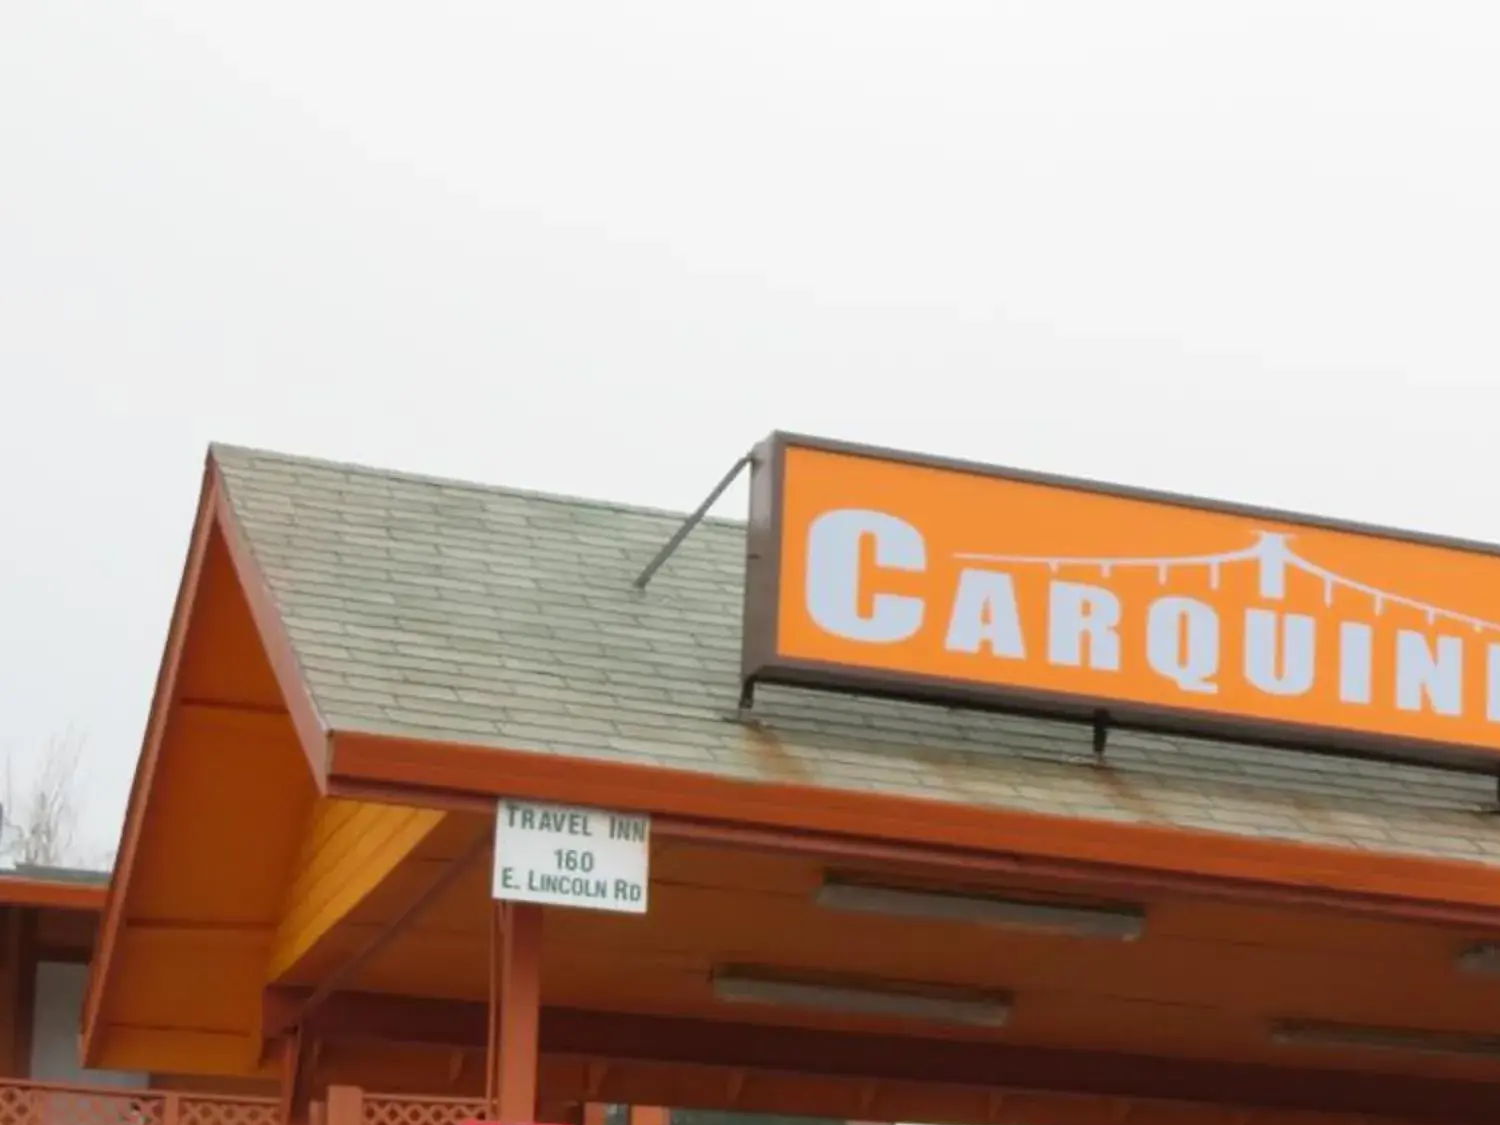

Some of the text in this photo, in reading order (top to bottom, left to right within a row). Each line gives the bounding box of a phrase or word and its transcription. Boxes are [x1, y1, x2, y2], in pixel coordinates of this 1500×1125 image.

[506, 801, 646, 843] TRAVEL INN
[554, 849, 595, 873] 160
[502, 867, 519, 890] E.
[527, 870, 607, 899] LINCOLN
